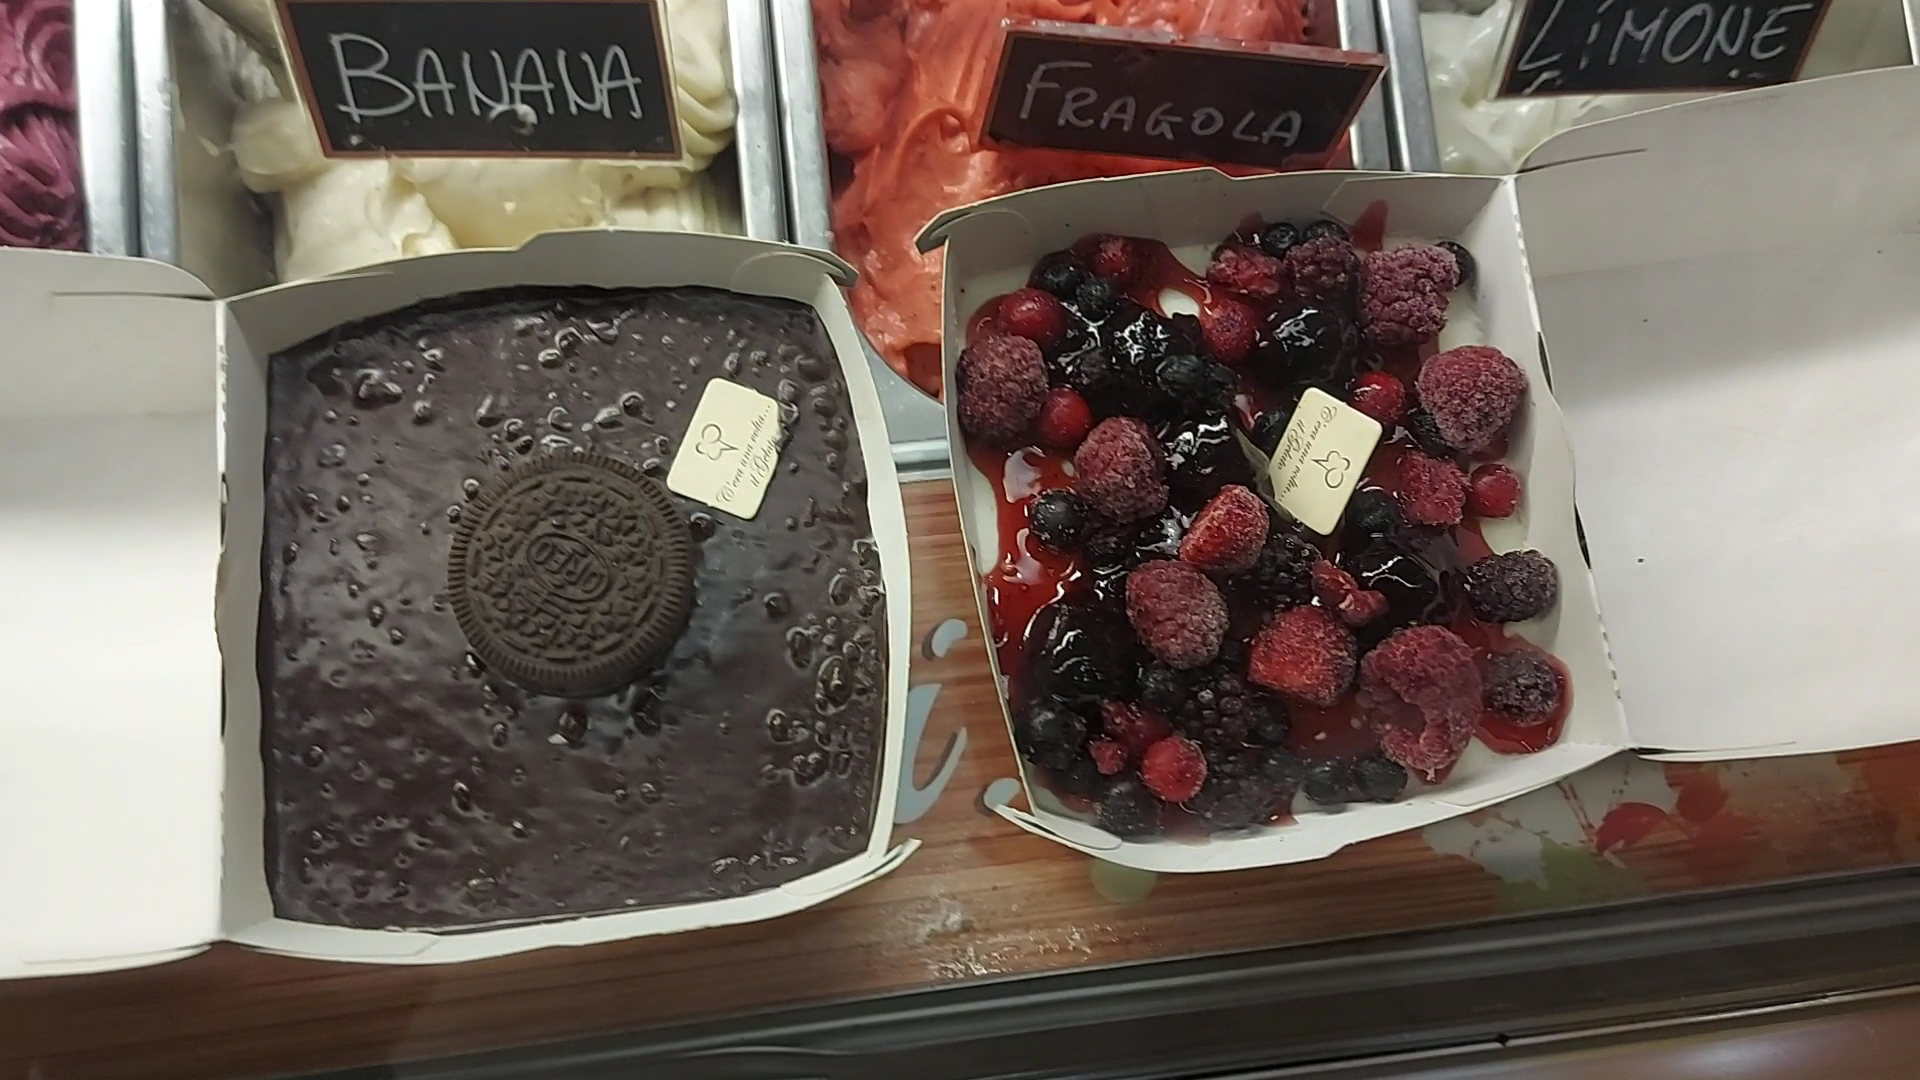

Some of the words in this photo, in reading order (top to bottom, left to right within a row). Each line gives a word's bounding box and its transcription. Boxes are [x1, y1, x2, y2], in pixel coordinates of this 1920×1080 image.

[328, 32, 642, 122] BANANA
[1018, 60, 1302, 148] FRAGOLA
[740, 443, 752, 468] una
[1277, 427, 1303, 471] Gelato
[1299, 440, 1313, 466] una
[533, 541, 601, 594] OREO
